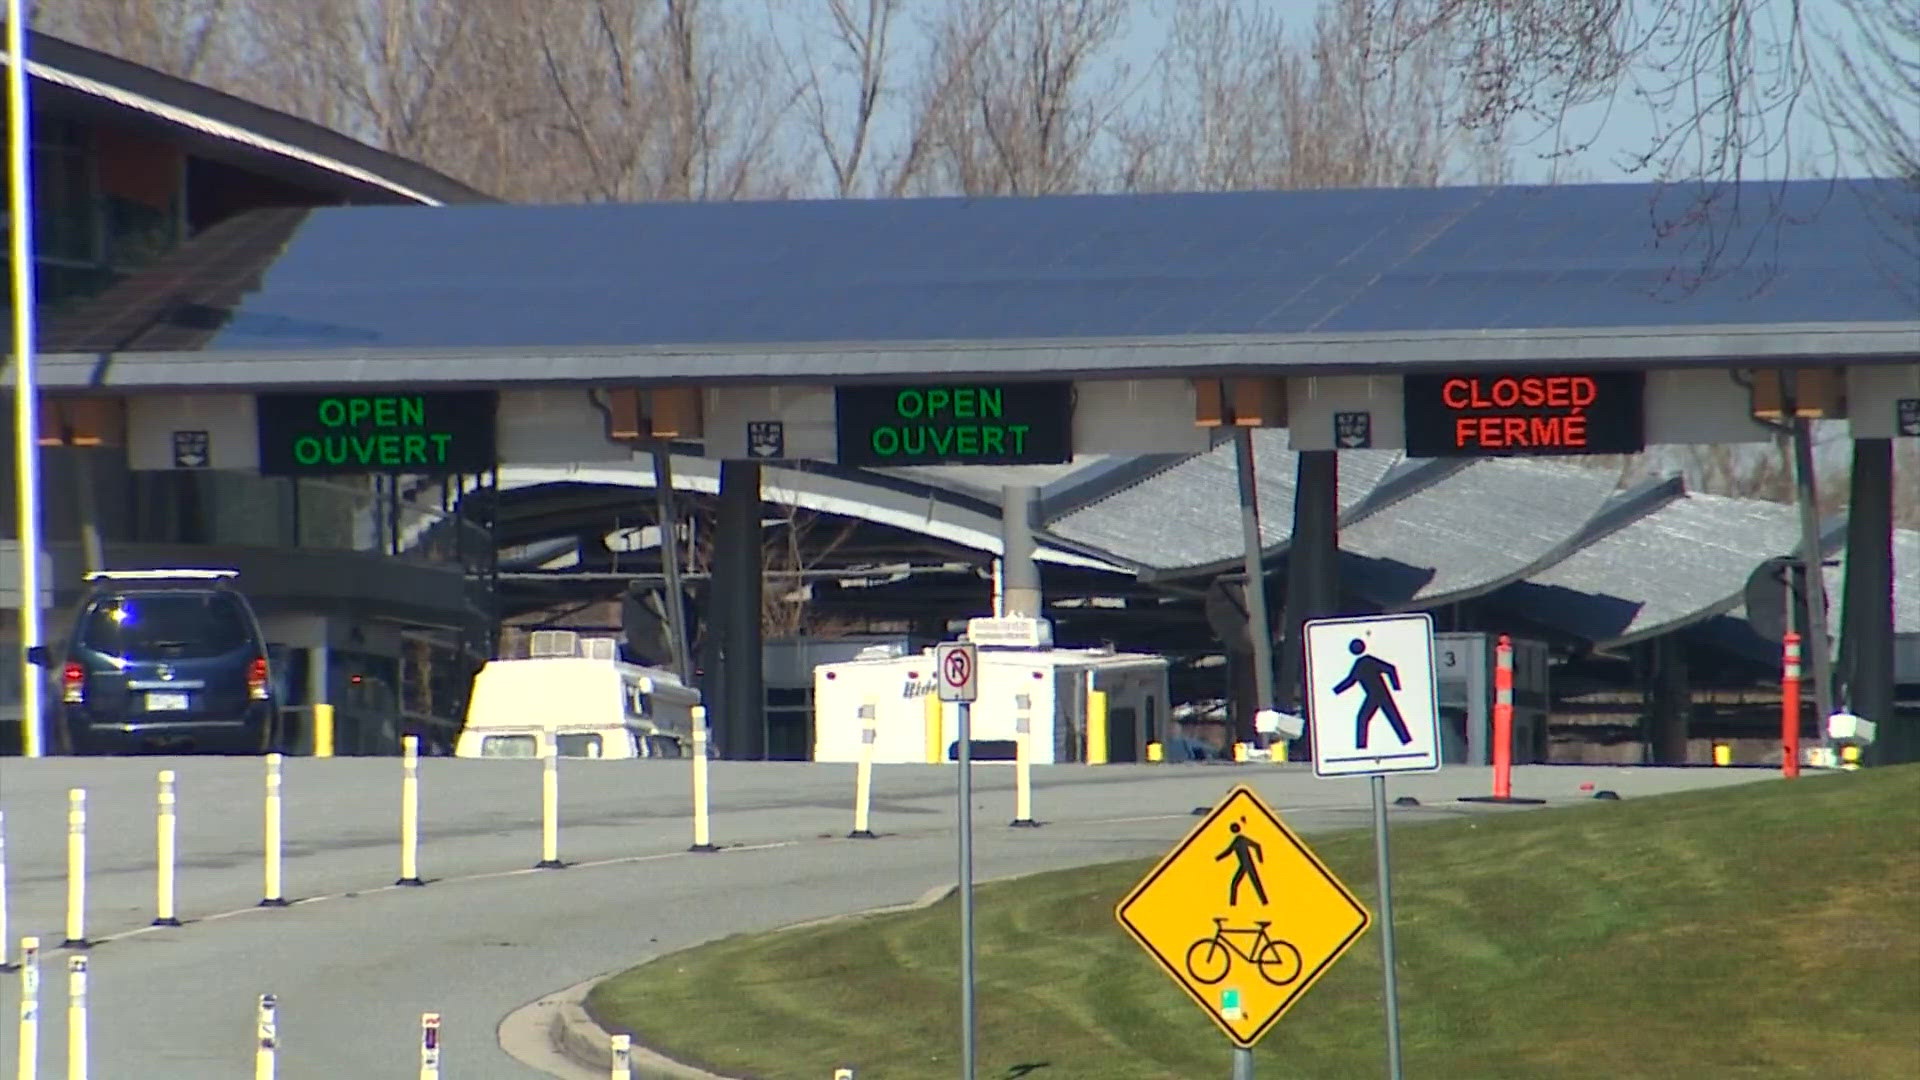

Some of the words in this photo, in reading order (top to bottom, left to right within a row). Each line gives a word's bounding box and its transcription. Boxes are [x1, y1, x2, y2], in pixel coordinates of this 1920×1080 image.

[898, 391, 1001, 418] OPEN
[1444, 378, 1595, 408] CLOSED
[320, 398, 423, 426] OPEN
[873, 426, 1029, 455] OUVERT
[1457, 408, 1584, 446] FERMÉ
[295, 433, 452, 465] OUVERT
[1443, 650, 1456, 667] 3
